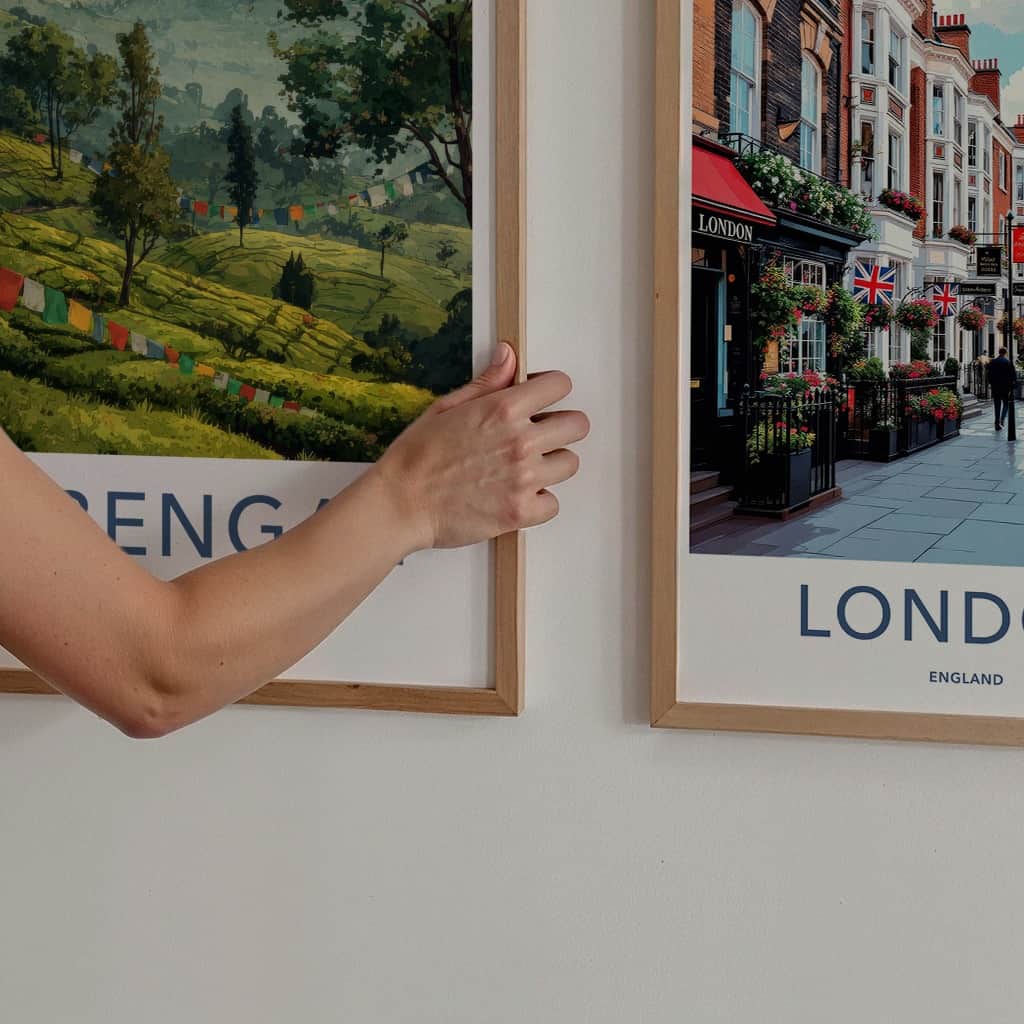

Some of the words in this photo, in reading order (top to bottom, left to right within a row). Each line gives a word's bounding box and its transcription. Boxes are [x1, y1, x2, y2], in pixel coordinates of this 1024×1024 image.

[699, 214, 753, 242] LONDON
[800, 584, 1024, 644] LOND
[929, 671, 1004, 686] ENGLAND
